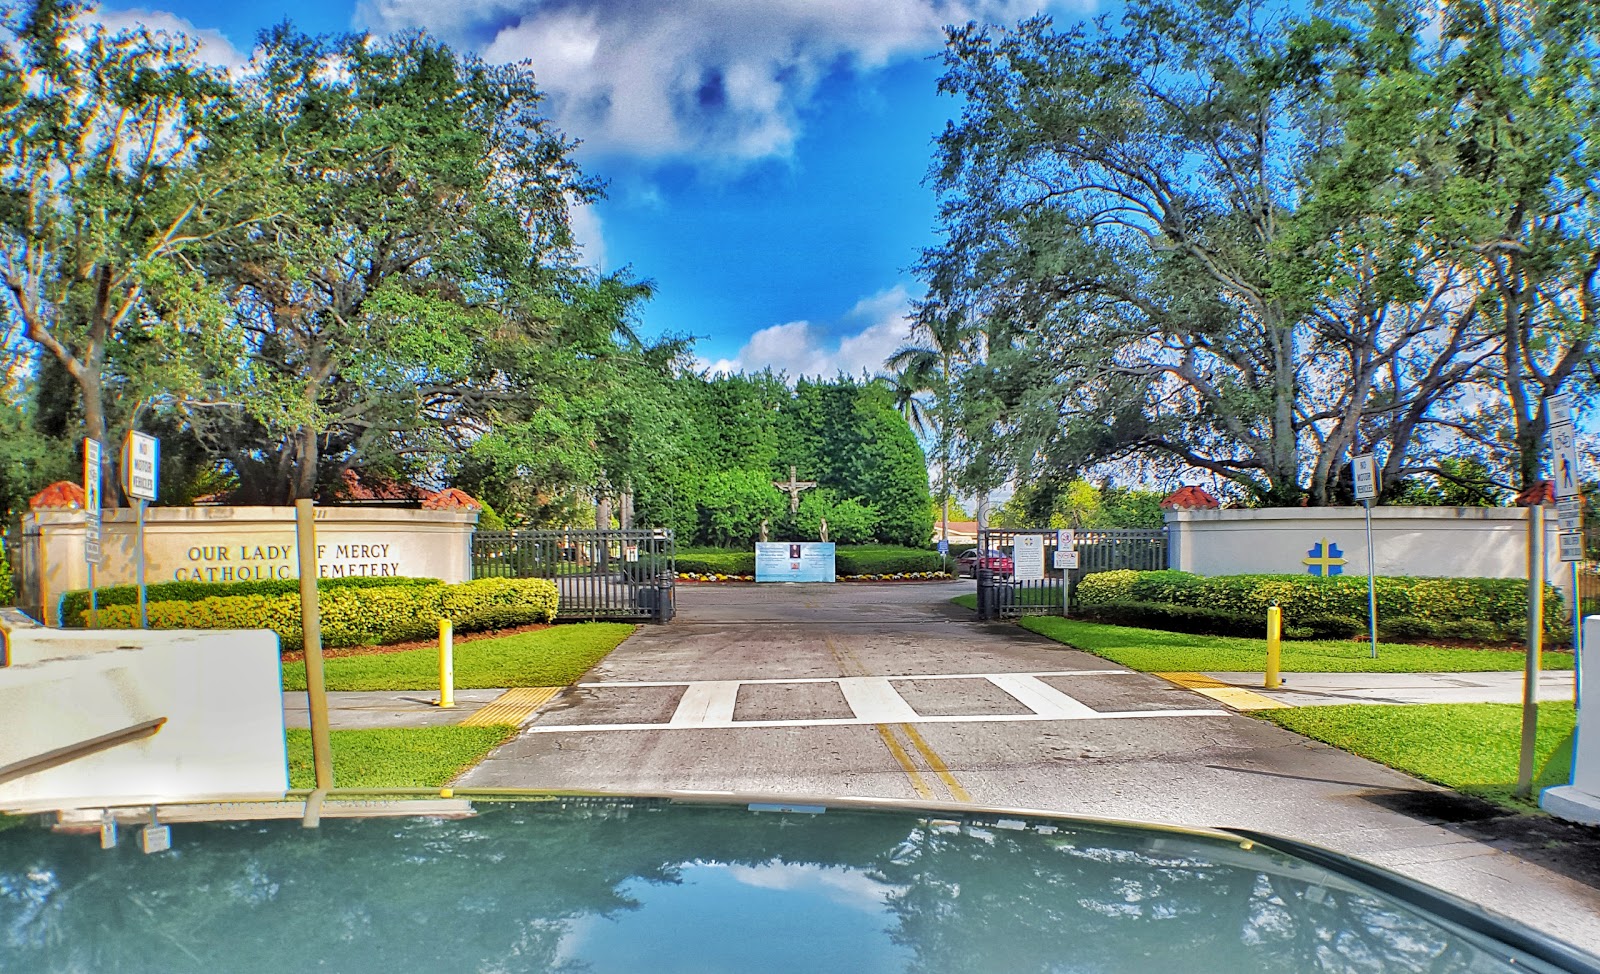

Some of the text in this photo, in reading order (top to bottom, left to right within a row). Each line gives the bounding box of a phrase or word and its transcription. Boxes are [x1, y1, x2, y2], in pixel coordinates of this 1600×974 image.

[138, 442, 148, 455] NO
[134, 459, 152, 473] MOTOR
[133, 476, 153, 491] VEHICLES
[188, 544, 390, 561] OUR LADY F MERCY
[174, 563, 399, 582] CATHOLIC EMETERY
